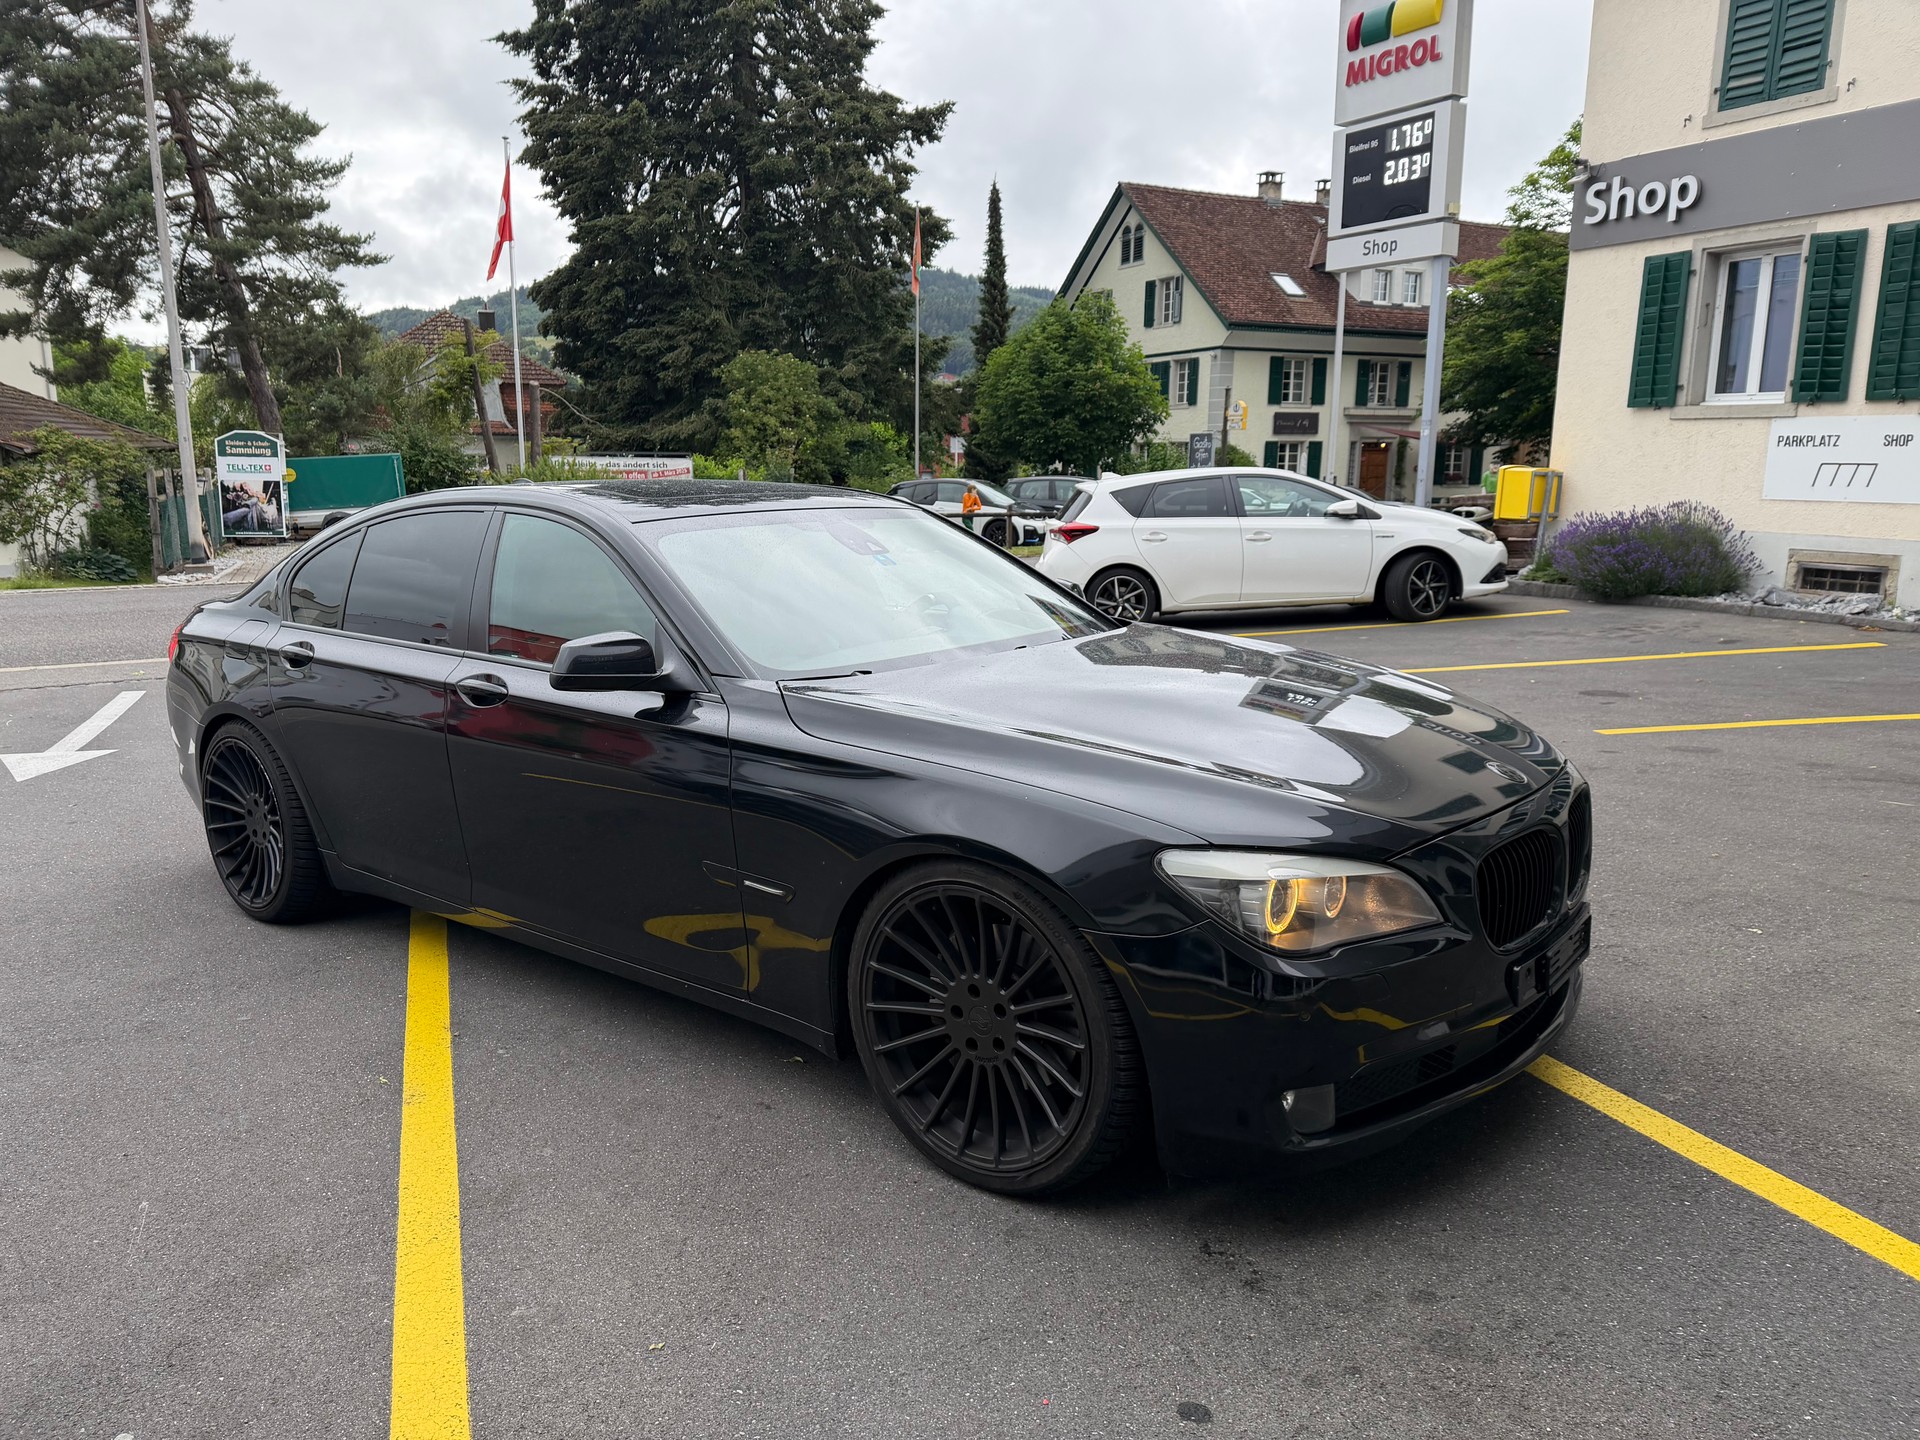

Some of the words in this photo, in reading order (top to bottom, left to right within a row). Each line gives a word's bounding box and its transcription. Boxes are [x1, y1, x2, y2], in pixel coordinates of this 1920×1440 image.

[1345, 35, 1442, 87] MIGROL
[1349, 141, 1370, 153] Bleifrei
[1370, 139, 1379, 148] 95
[1352, 173, 1372, 184] Diesel
[1583, 174, 1701, 225] Shop
[1362, 239, 1398, 256] Shop
[1193, 436, 1212, 449] Gastro
[1777, 434, 1841, 448] PARKPLATZ
[1883, 434, 1914, 447] SHOP
[225, 446, 271, 456] Sammlung
[226, 463, 263, 471] TELL-TEX
[607, 460, 620, 469] das
[623, 460, 649, 469] ändert
[652, 461, 668, 469] sich
[628, 471, 646, 479] offen
